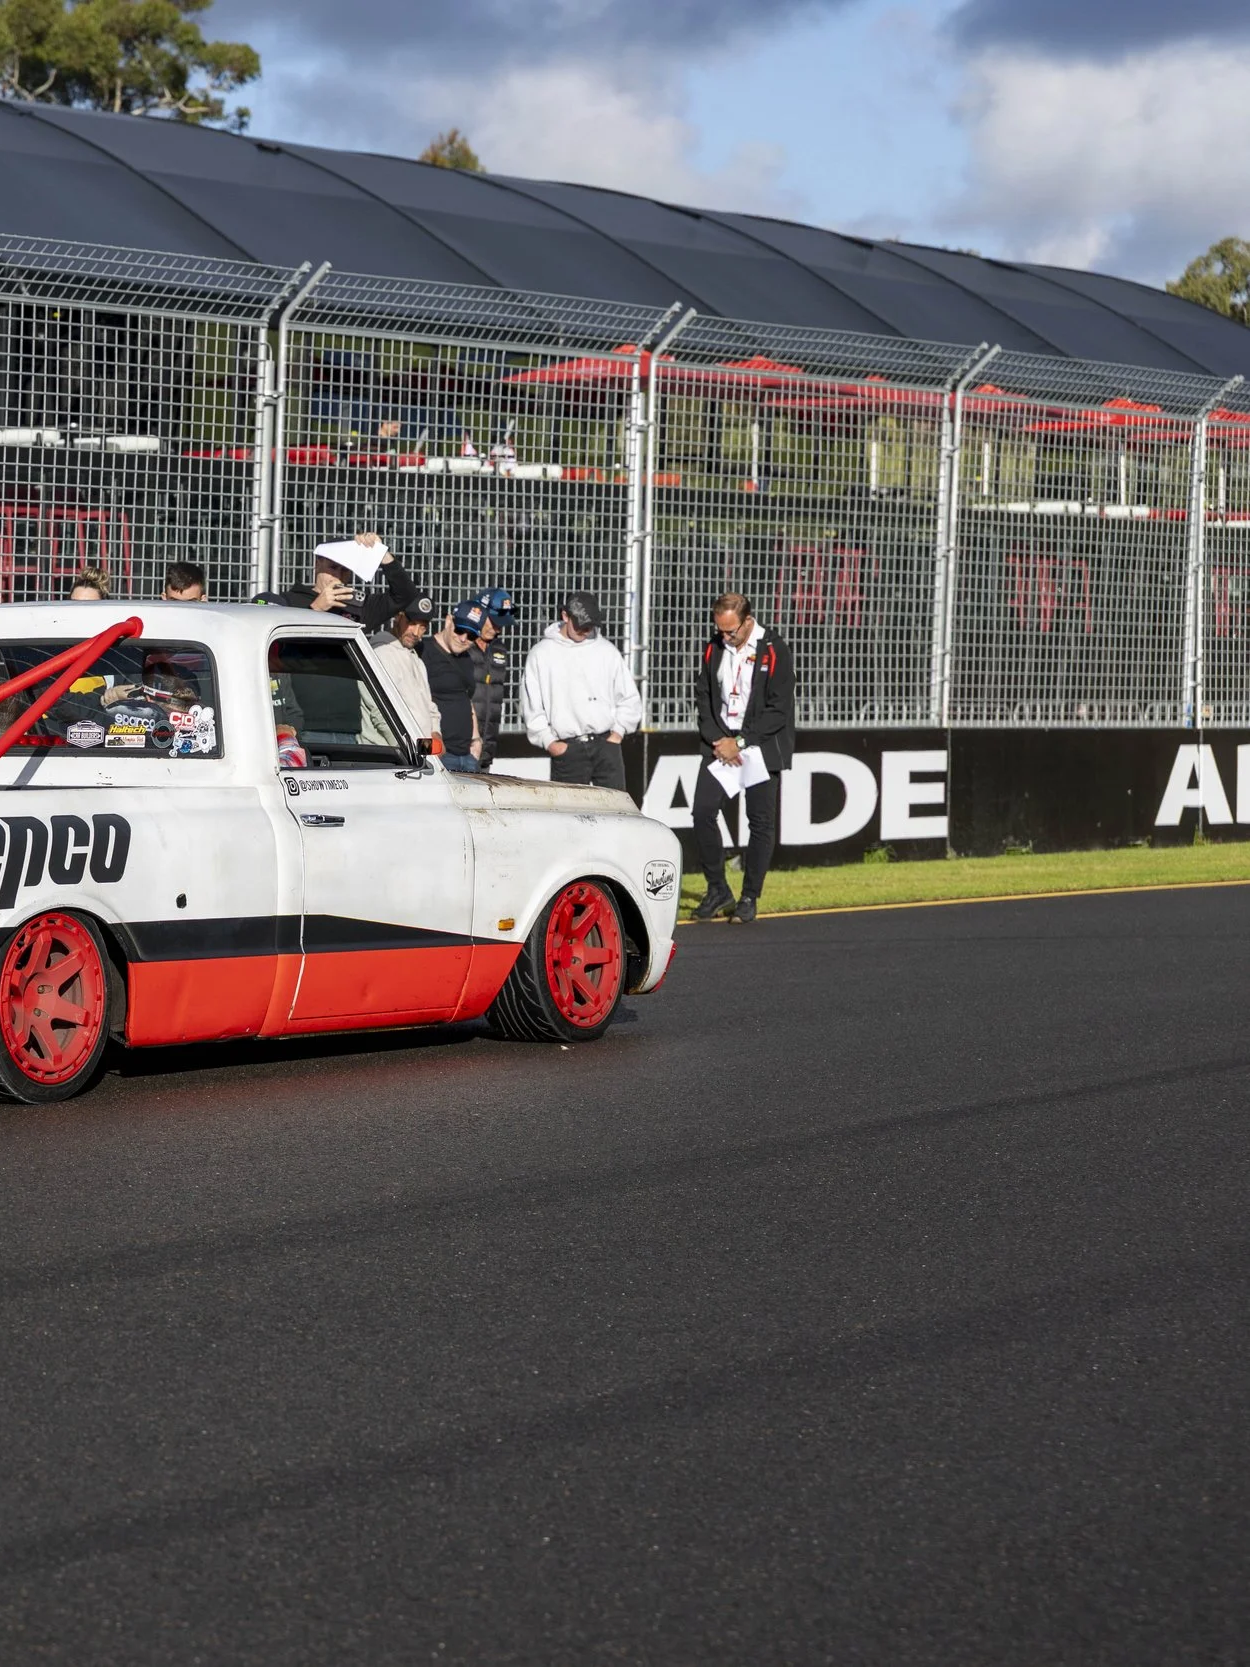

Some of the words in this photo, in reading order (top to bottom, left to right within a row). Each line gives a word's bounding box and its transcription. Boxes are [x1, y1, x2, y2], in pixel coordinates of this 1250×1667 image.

[109, 725, 146, 734] Haltech
[114, 713, 156, 732] sparco
[642, 750, 948, 848] ADE
[1154, 743, 1250, 826] A
